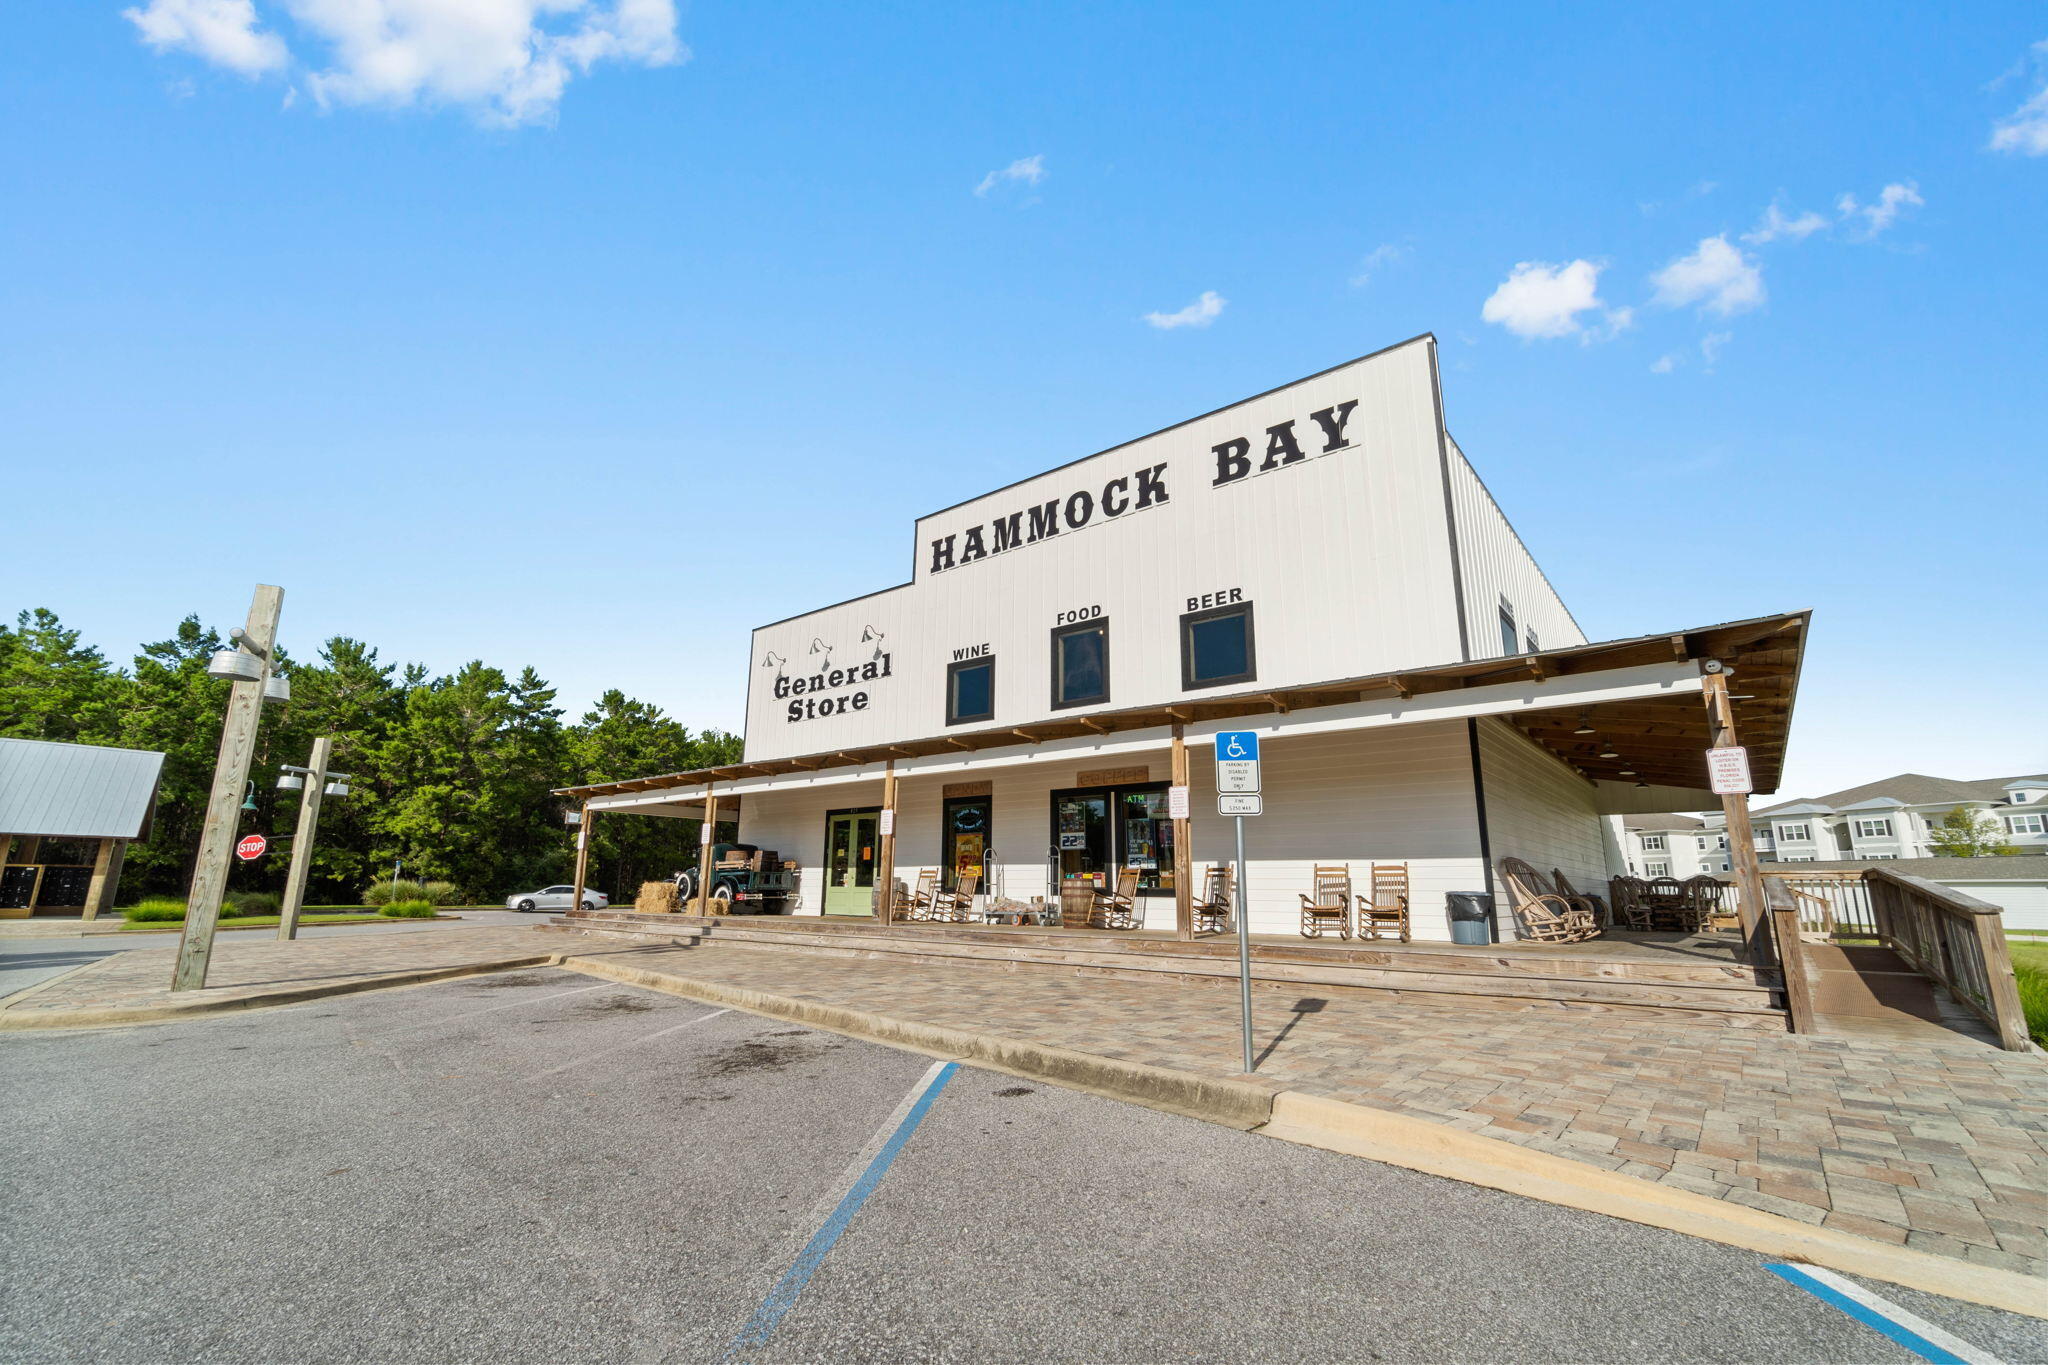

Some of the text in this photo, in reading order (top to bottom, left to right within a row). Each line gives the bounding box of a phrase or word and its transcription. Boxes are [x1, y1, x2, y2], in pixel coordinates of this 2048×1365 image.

[931, 399, 1361, 574] HAMMOCK BAY
[1187, 587, 1243, 612] BEER
[1057, 604, 1101, 626] FOOD
[953, 643, 990, 661] WINE
[774, 653, 892, 699] General
[787, 691, 868, 723] Store
[1127, 794, 1145, 804] ATM
[239, 842, 264, 853] STOP
